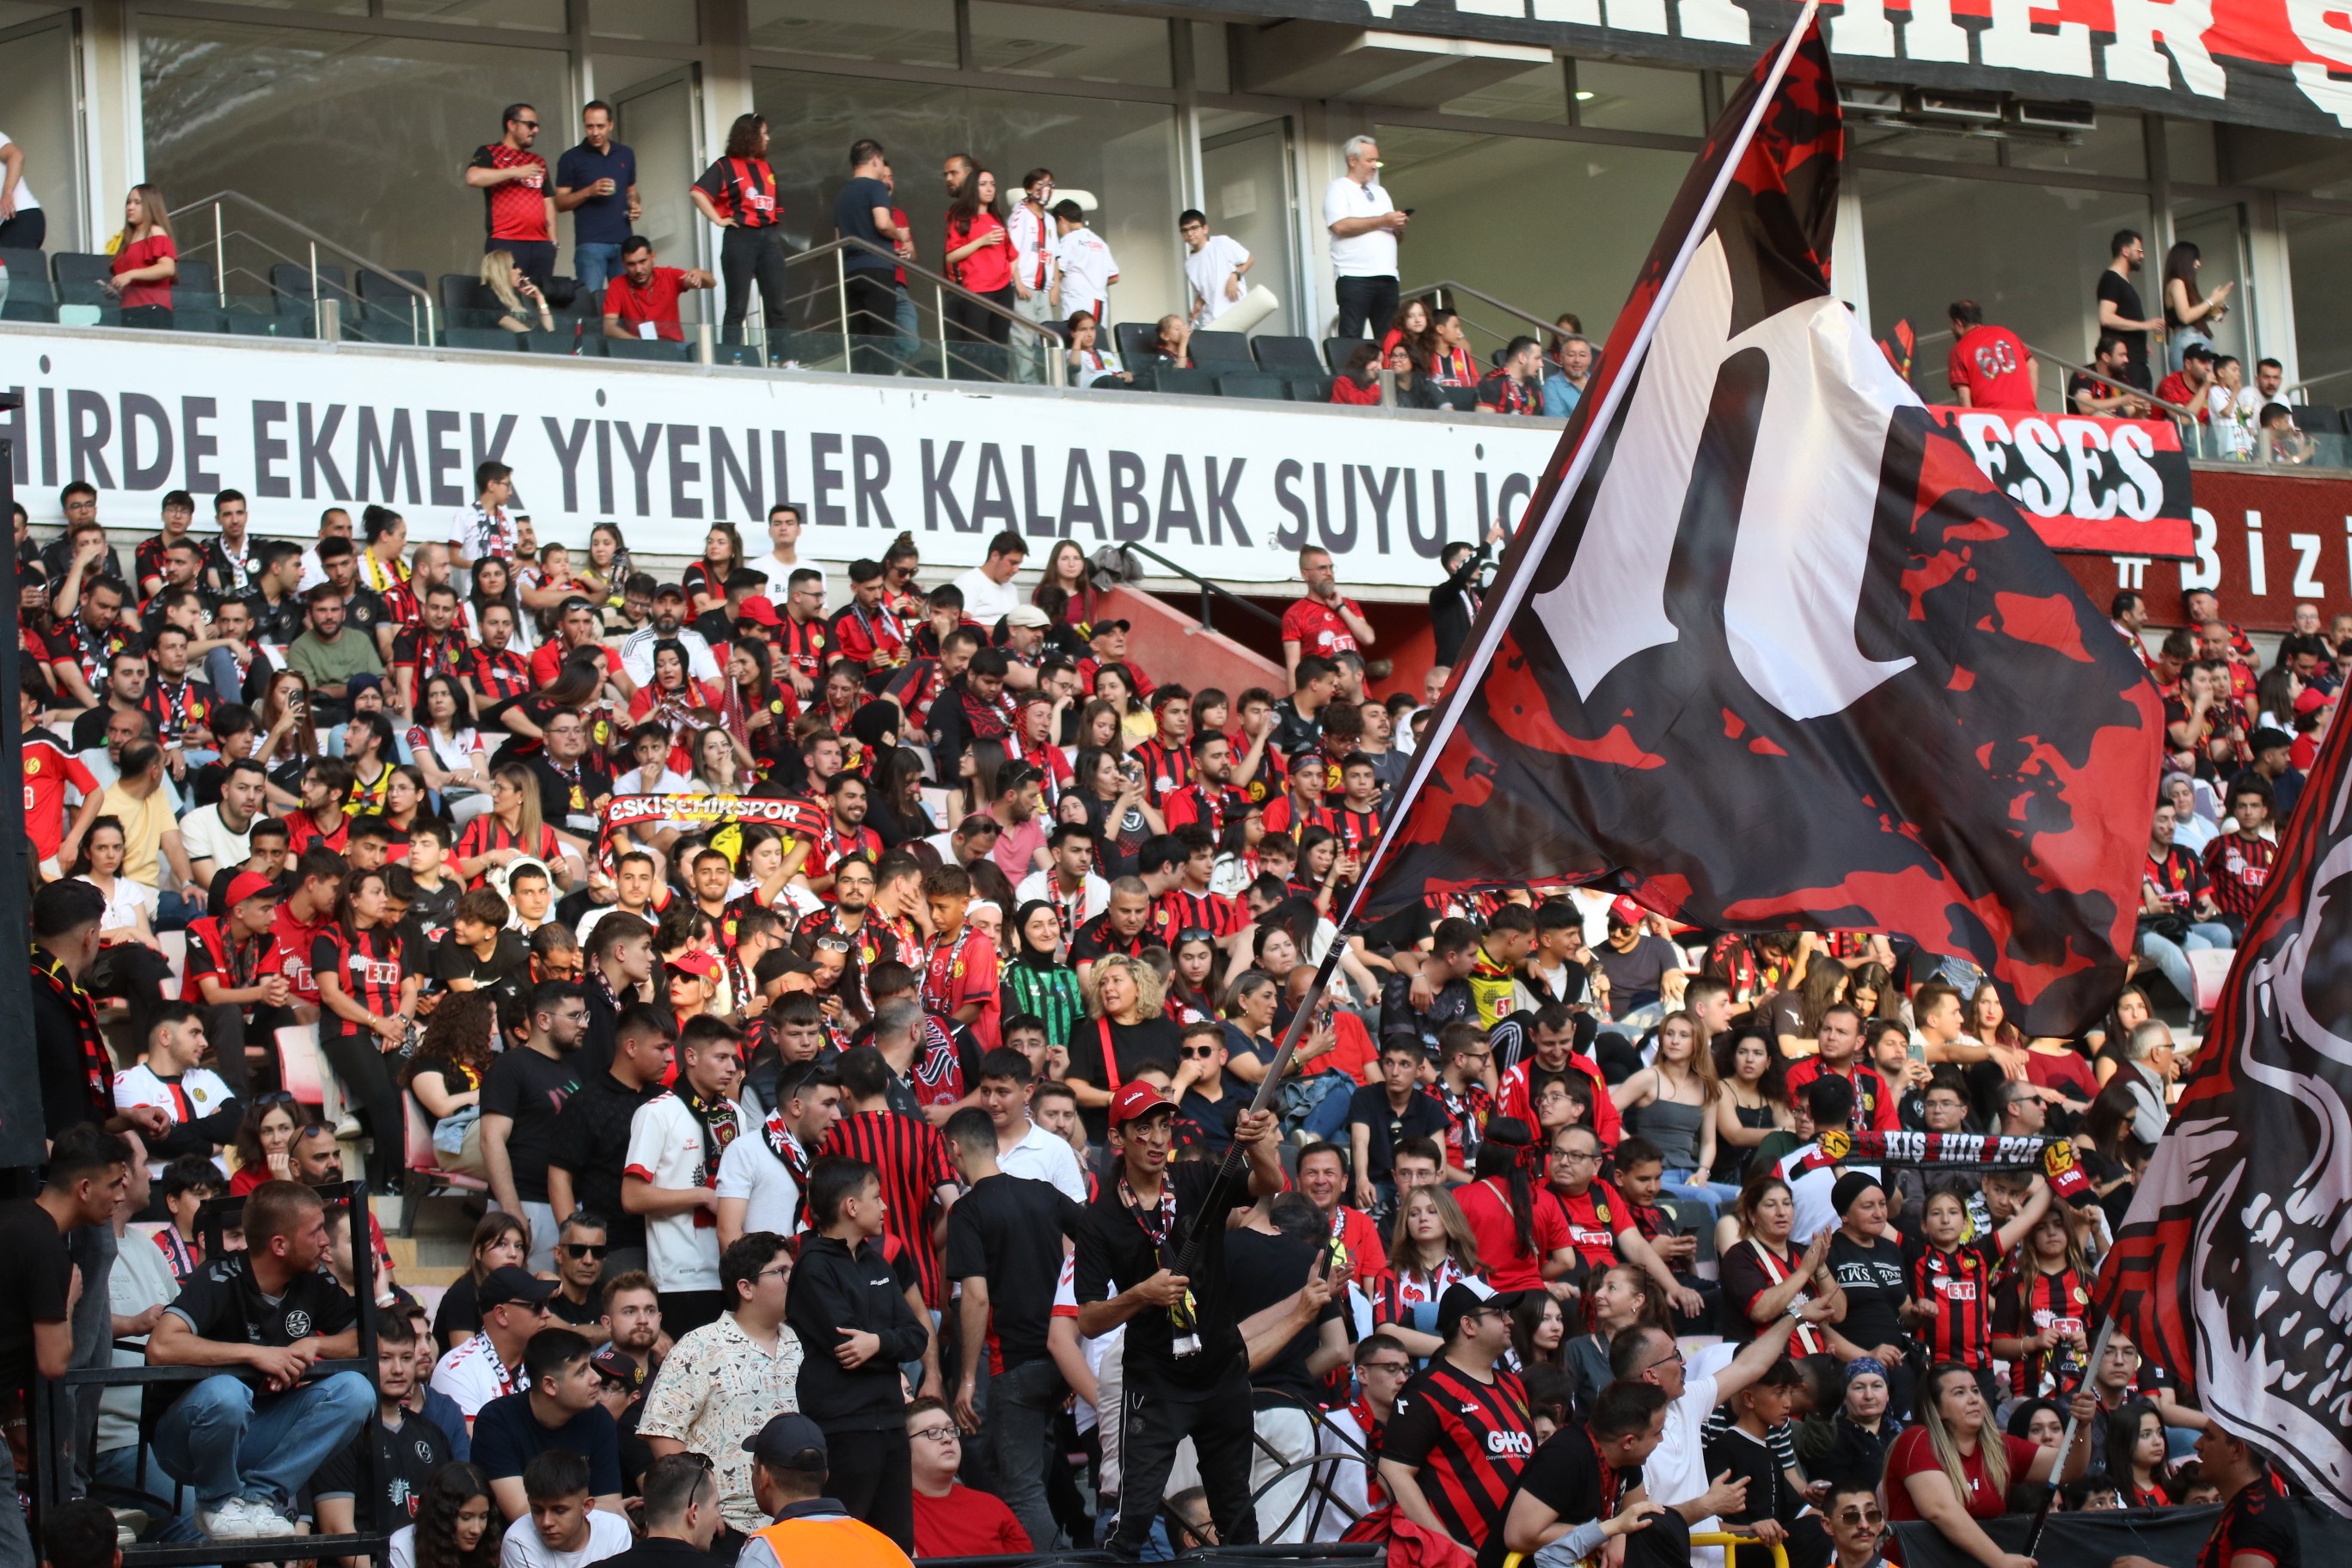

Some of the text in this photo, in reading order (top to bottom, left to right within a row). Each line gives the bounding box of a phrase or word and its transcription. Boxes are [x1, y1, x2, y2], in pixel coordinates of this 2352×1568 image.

[1975, 339, 2015, 379] 60
[252, 400, 524, 509] EKMEK
[542, 388, 896, 530] YİYENLER
[921, 438, 1254, 548] KALABAK
[1274, 458, 1447, 560] SUYU
[1958, 413, 2164, 523] ESES
[408, 731, 421, 746] 2
[1495, 997, 1514, 1018] ET
[1947, 1282, 1975, 1300] ETi
[1487, 1430, 1533, 1454] GHO
